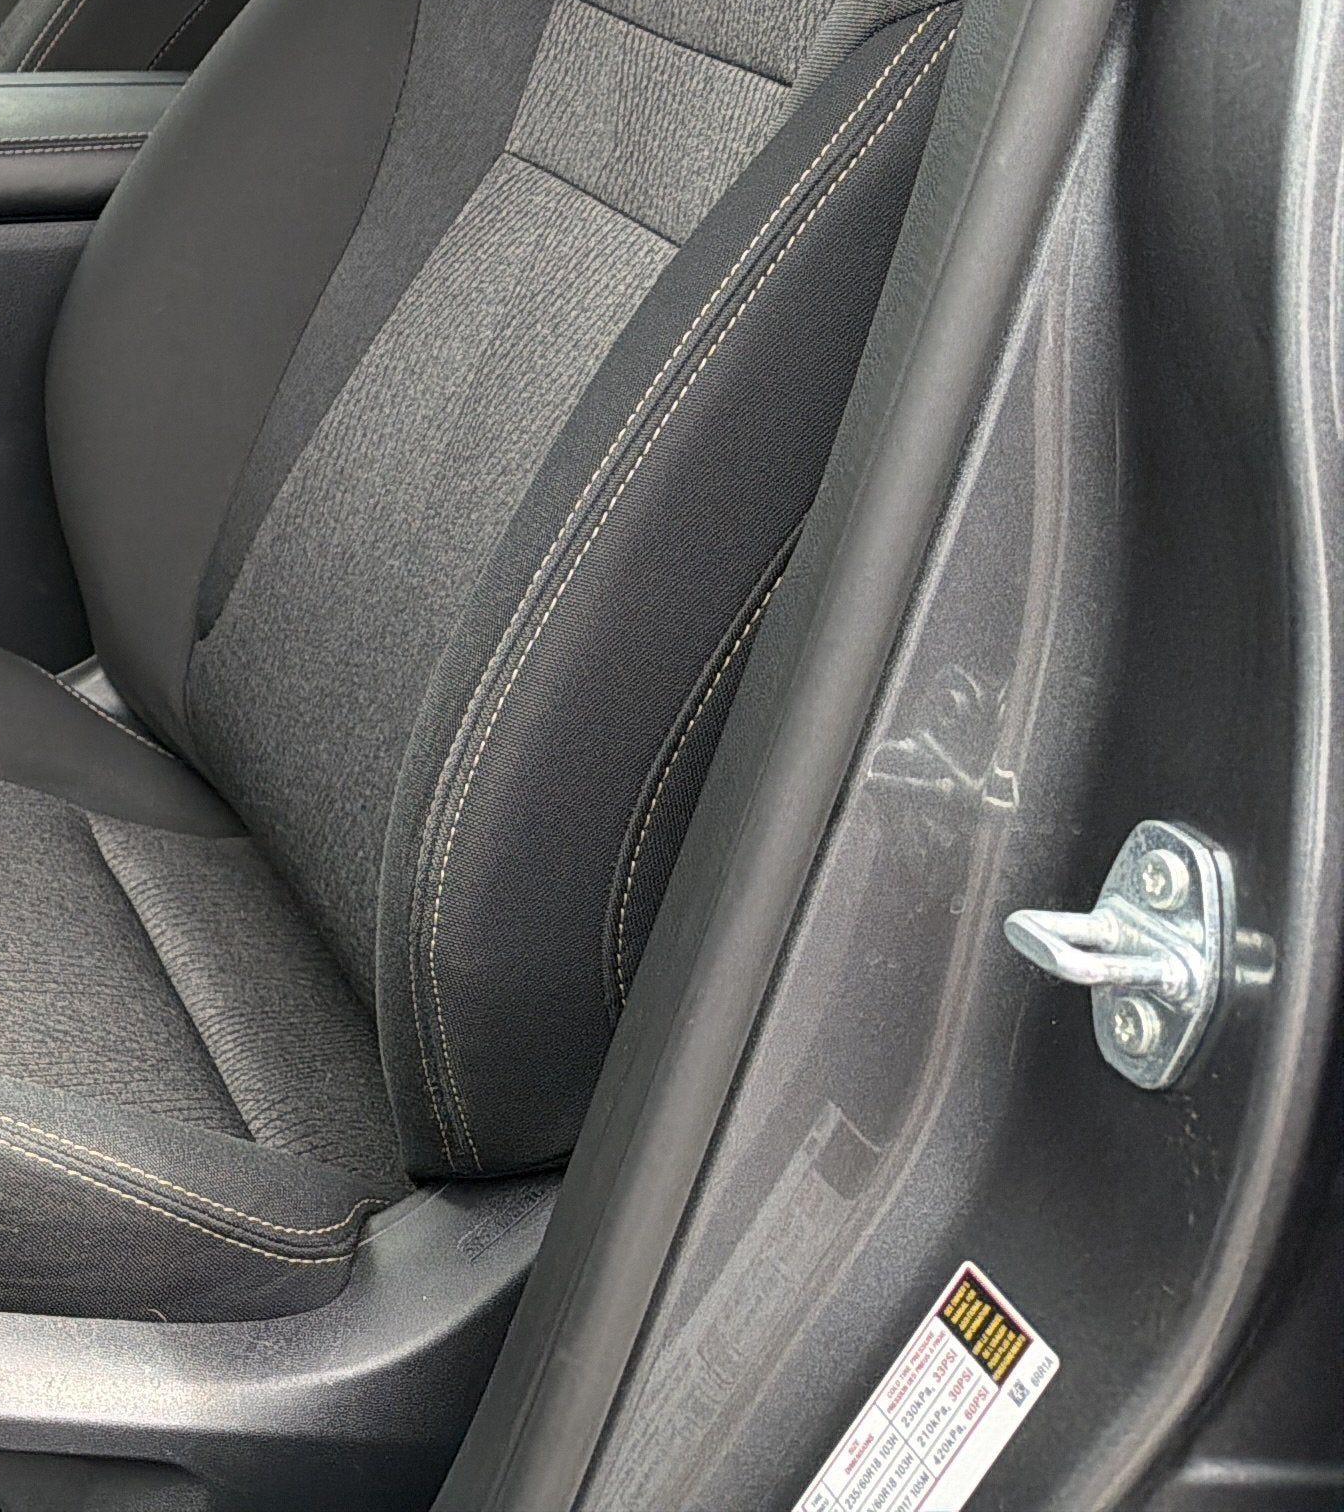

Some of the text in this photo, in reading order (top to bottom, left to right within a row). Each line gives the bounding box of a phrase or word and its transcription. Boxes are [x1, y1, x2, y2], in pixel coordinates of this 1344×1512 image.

[901, 1348, 958, 1428] 230kPa, 33PSI
[917, 1367, 974, 1448] 210kPa, 30PSI
[933, 1385, 990, 1465] 420kPa, 60PSI
[844, 1432, 899, 1510] 235/60R18 103H
[895, 1452, 914, 1479] 103H
